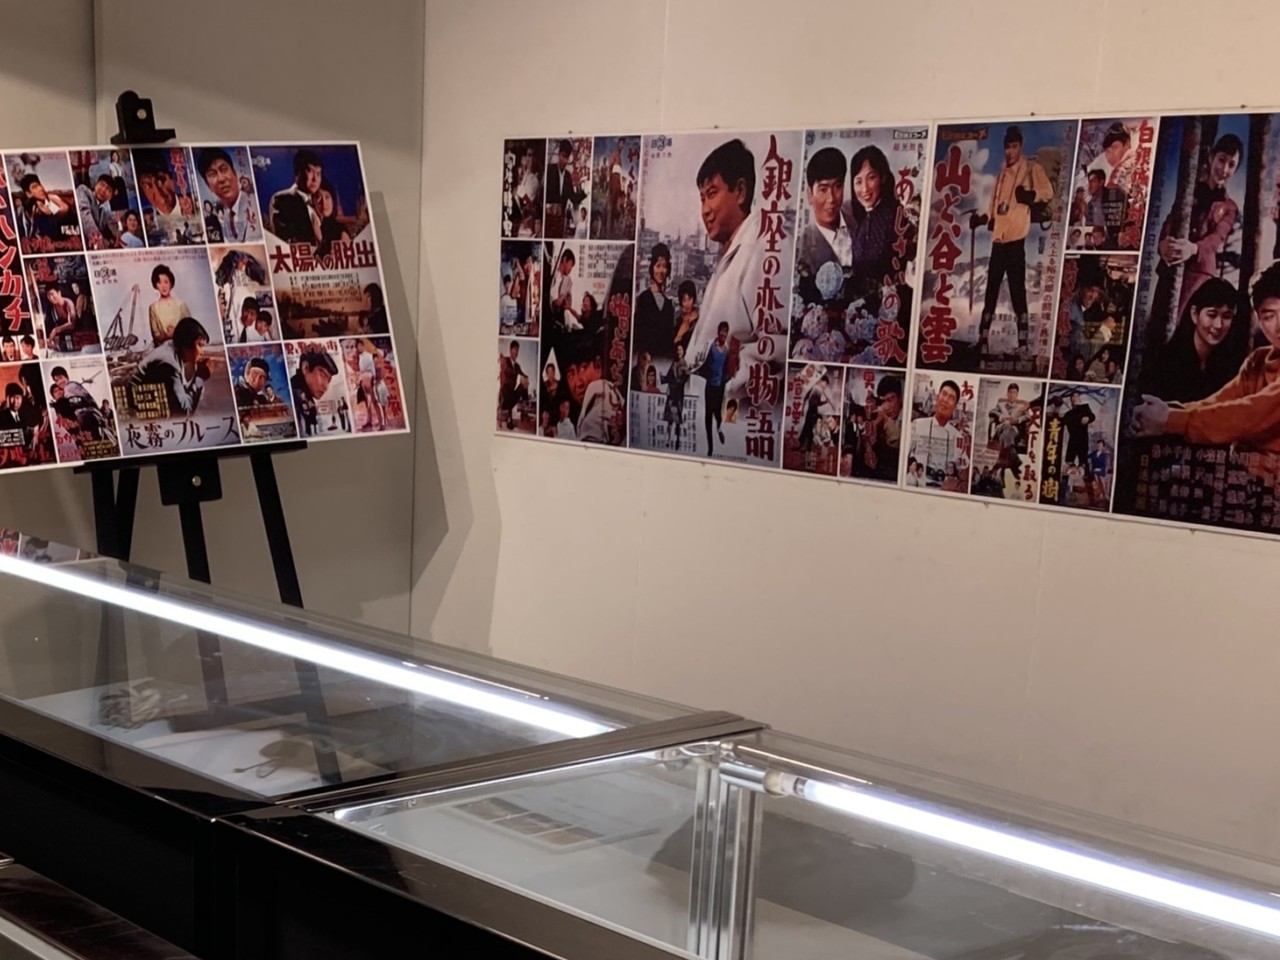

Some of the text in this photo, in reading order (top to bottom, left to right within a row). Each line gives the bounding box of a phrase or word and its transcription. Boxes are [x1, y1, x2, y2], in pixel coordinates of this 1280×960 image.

[270, 240, 377, 274] 太陽への脱出
[745, 134, 793, 461] 銀座の恋の物語
[921, 145, 971, 363] 山と谷と雲
[125, 416, 239, 449] 夜霧のブルース
[1023, 406, 1042, 500] 天下を取る
[1042, 418, 1061, 501] 青年の樹
